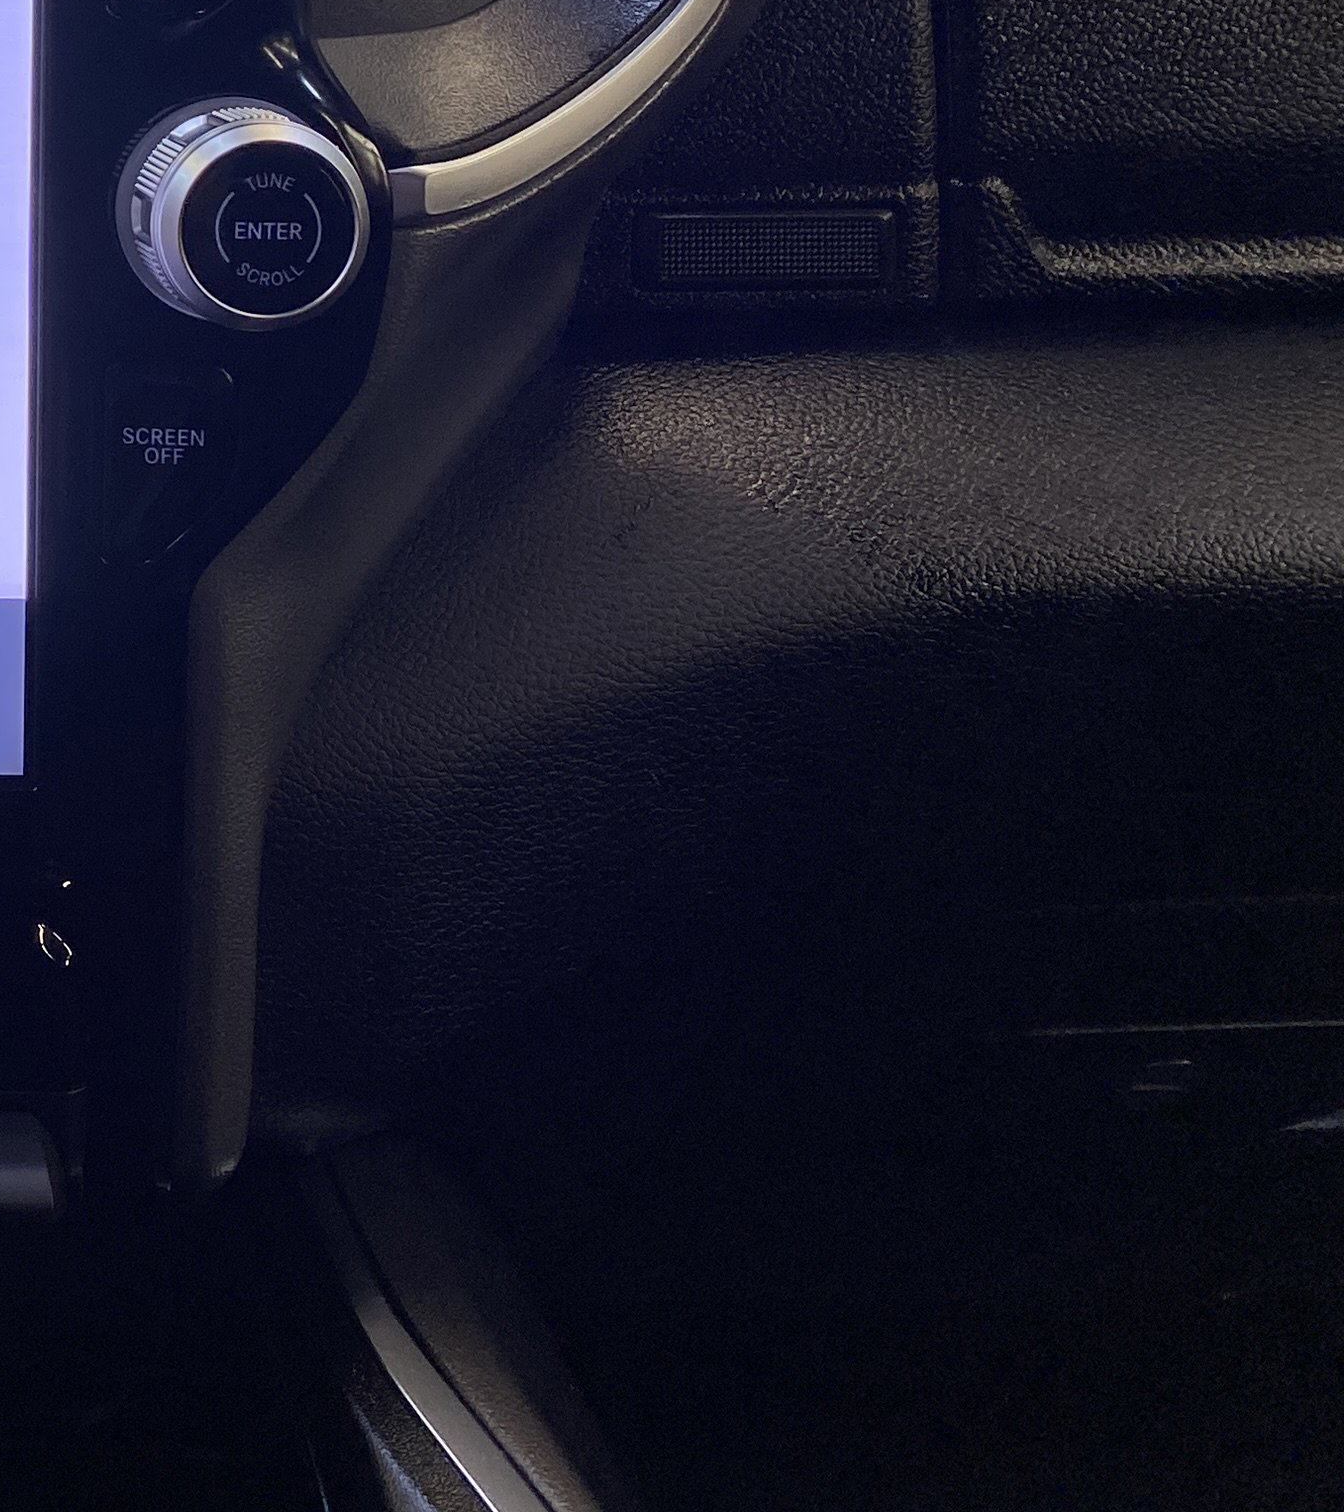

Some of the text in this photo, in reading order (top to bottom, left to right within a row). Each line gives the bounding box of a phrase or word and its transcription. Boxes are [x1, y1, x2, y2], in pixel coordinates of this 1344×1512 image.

[244, 172, 296, 193] TUNE
[234, 221, 303, 241] ENTER
[236, 262, 305, 287] SCROLL
[122, 427, 205, 449] SCREEN
[144, 447, 185, 465] OFF
